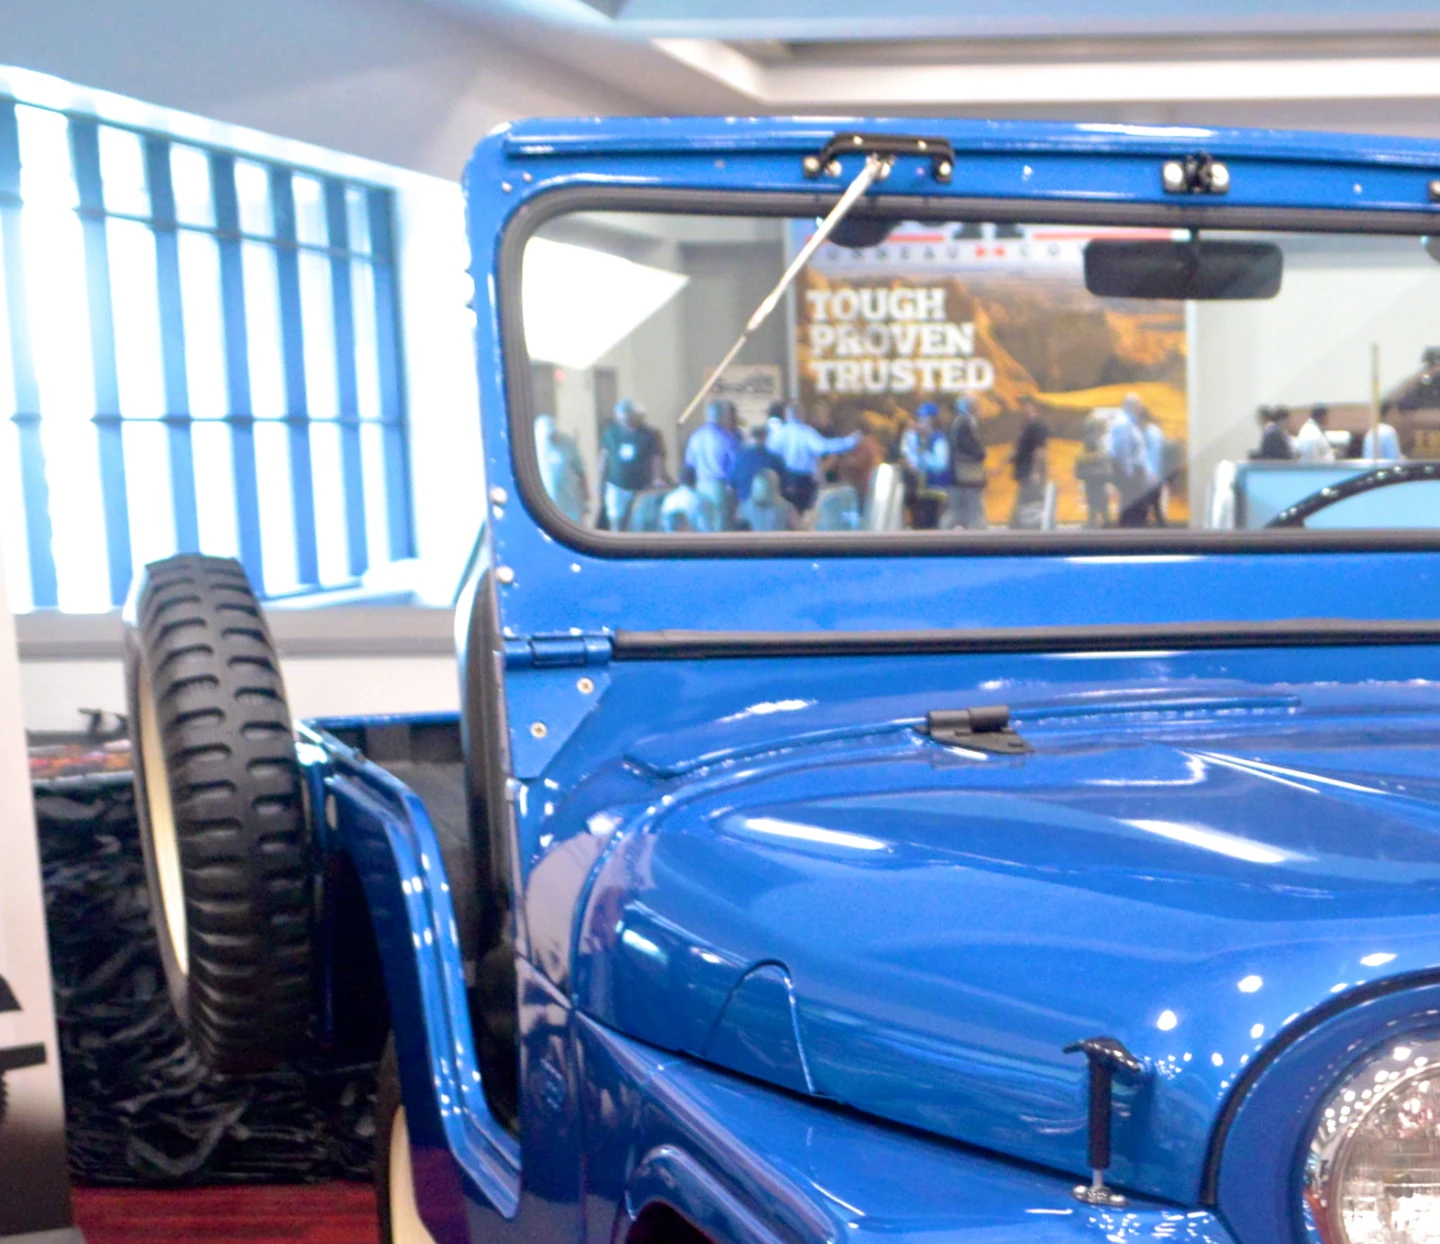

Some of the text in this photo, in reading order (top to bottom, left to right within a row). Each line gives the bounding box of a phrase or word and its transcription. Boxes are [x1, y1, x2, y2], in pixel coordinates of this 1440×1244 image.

[806, 288, 947, 321] TOUGH
[808, 322, 976, 357] PROVEN
[809, 357, 995, 392] TRUSTED
